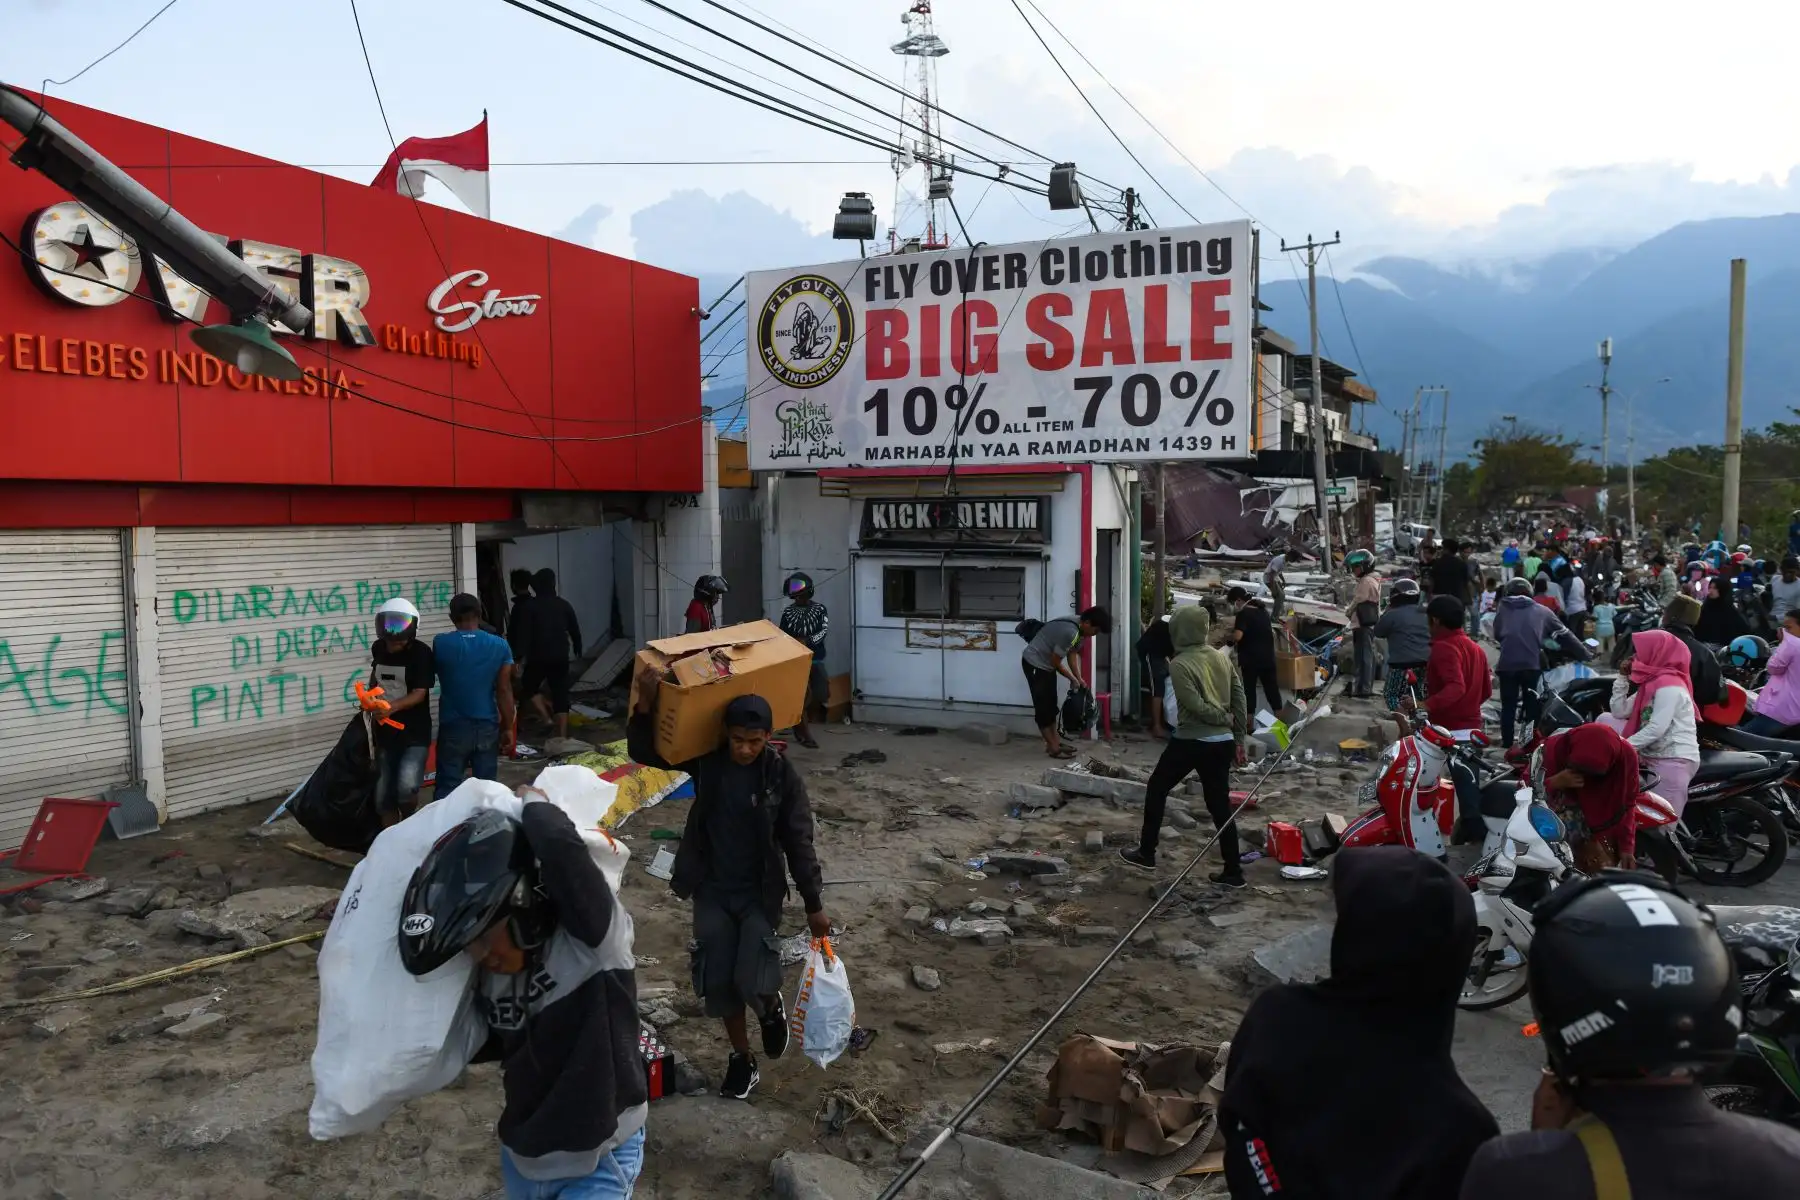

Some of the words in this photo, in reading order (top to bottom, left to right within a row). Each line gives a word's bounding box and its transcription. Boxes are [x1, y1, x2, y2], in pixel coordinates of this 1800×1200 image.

[865, 262, 919, 301] FLY
[930, 252, 1028, 296] OVER
[1040, 237, 1233, 285] Clothing
[427, 269, 542, 333] Store
[769, 284, 794, 313] FLY
[383, 323, 483, 369] Clothing
[775, 329, 792, 338] SINCE
[865, 299, 998, 381] BIG
[1025, 279, 1233, 372] SALE
[0, 333, 149, 380] ELEBES
[764, 347, 785, 375] PLW
[785, 340, 850, 384] INDONESIA
[864, 382, 1001, 437] 10%
[1074, 369, 1235, 428] 70%
[865, 444, 974, 461] MARHABAN
[980, 442, 1020, 458] YAA
[1028, 437, 1150, 456] RAMADHAN
[1159, 435, 1212, 452] 1439
[1221, 435, 1236, 450] H
[1003, 420, 1034, 434] ALL
[1037, 420, 1074, 433] ITEM
[872, 503, 930, 529] KICK
[957, 502, 1037, 529] DENIM
[174, 585, 347, 624] DILARANG
[231, 633, 263, 670] DI
[276, 623, 370, 662] DEPAN
[191, 664, 325, 728] PINTU
[404, 917, 429, 931] NHK
